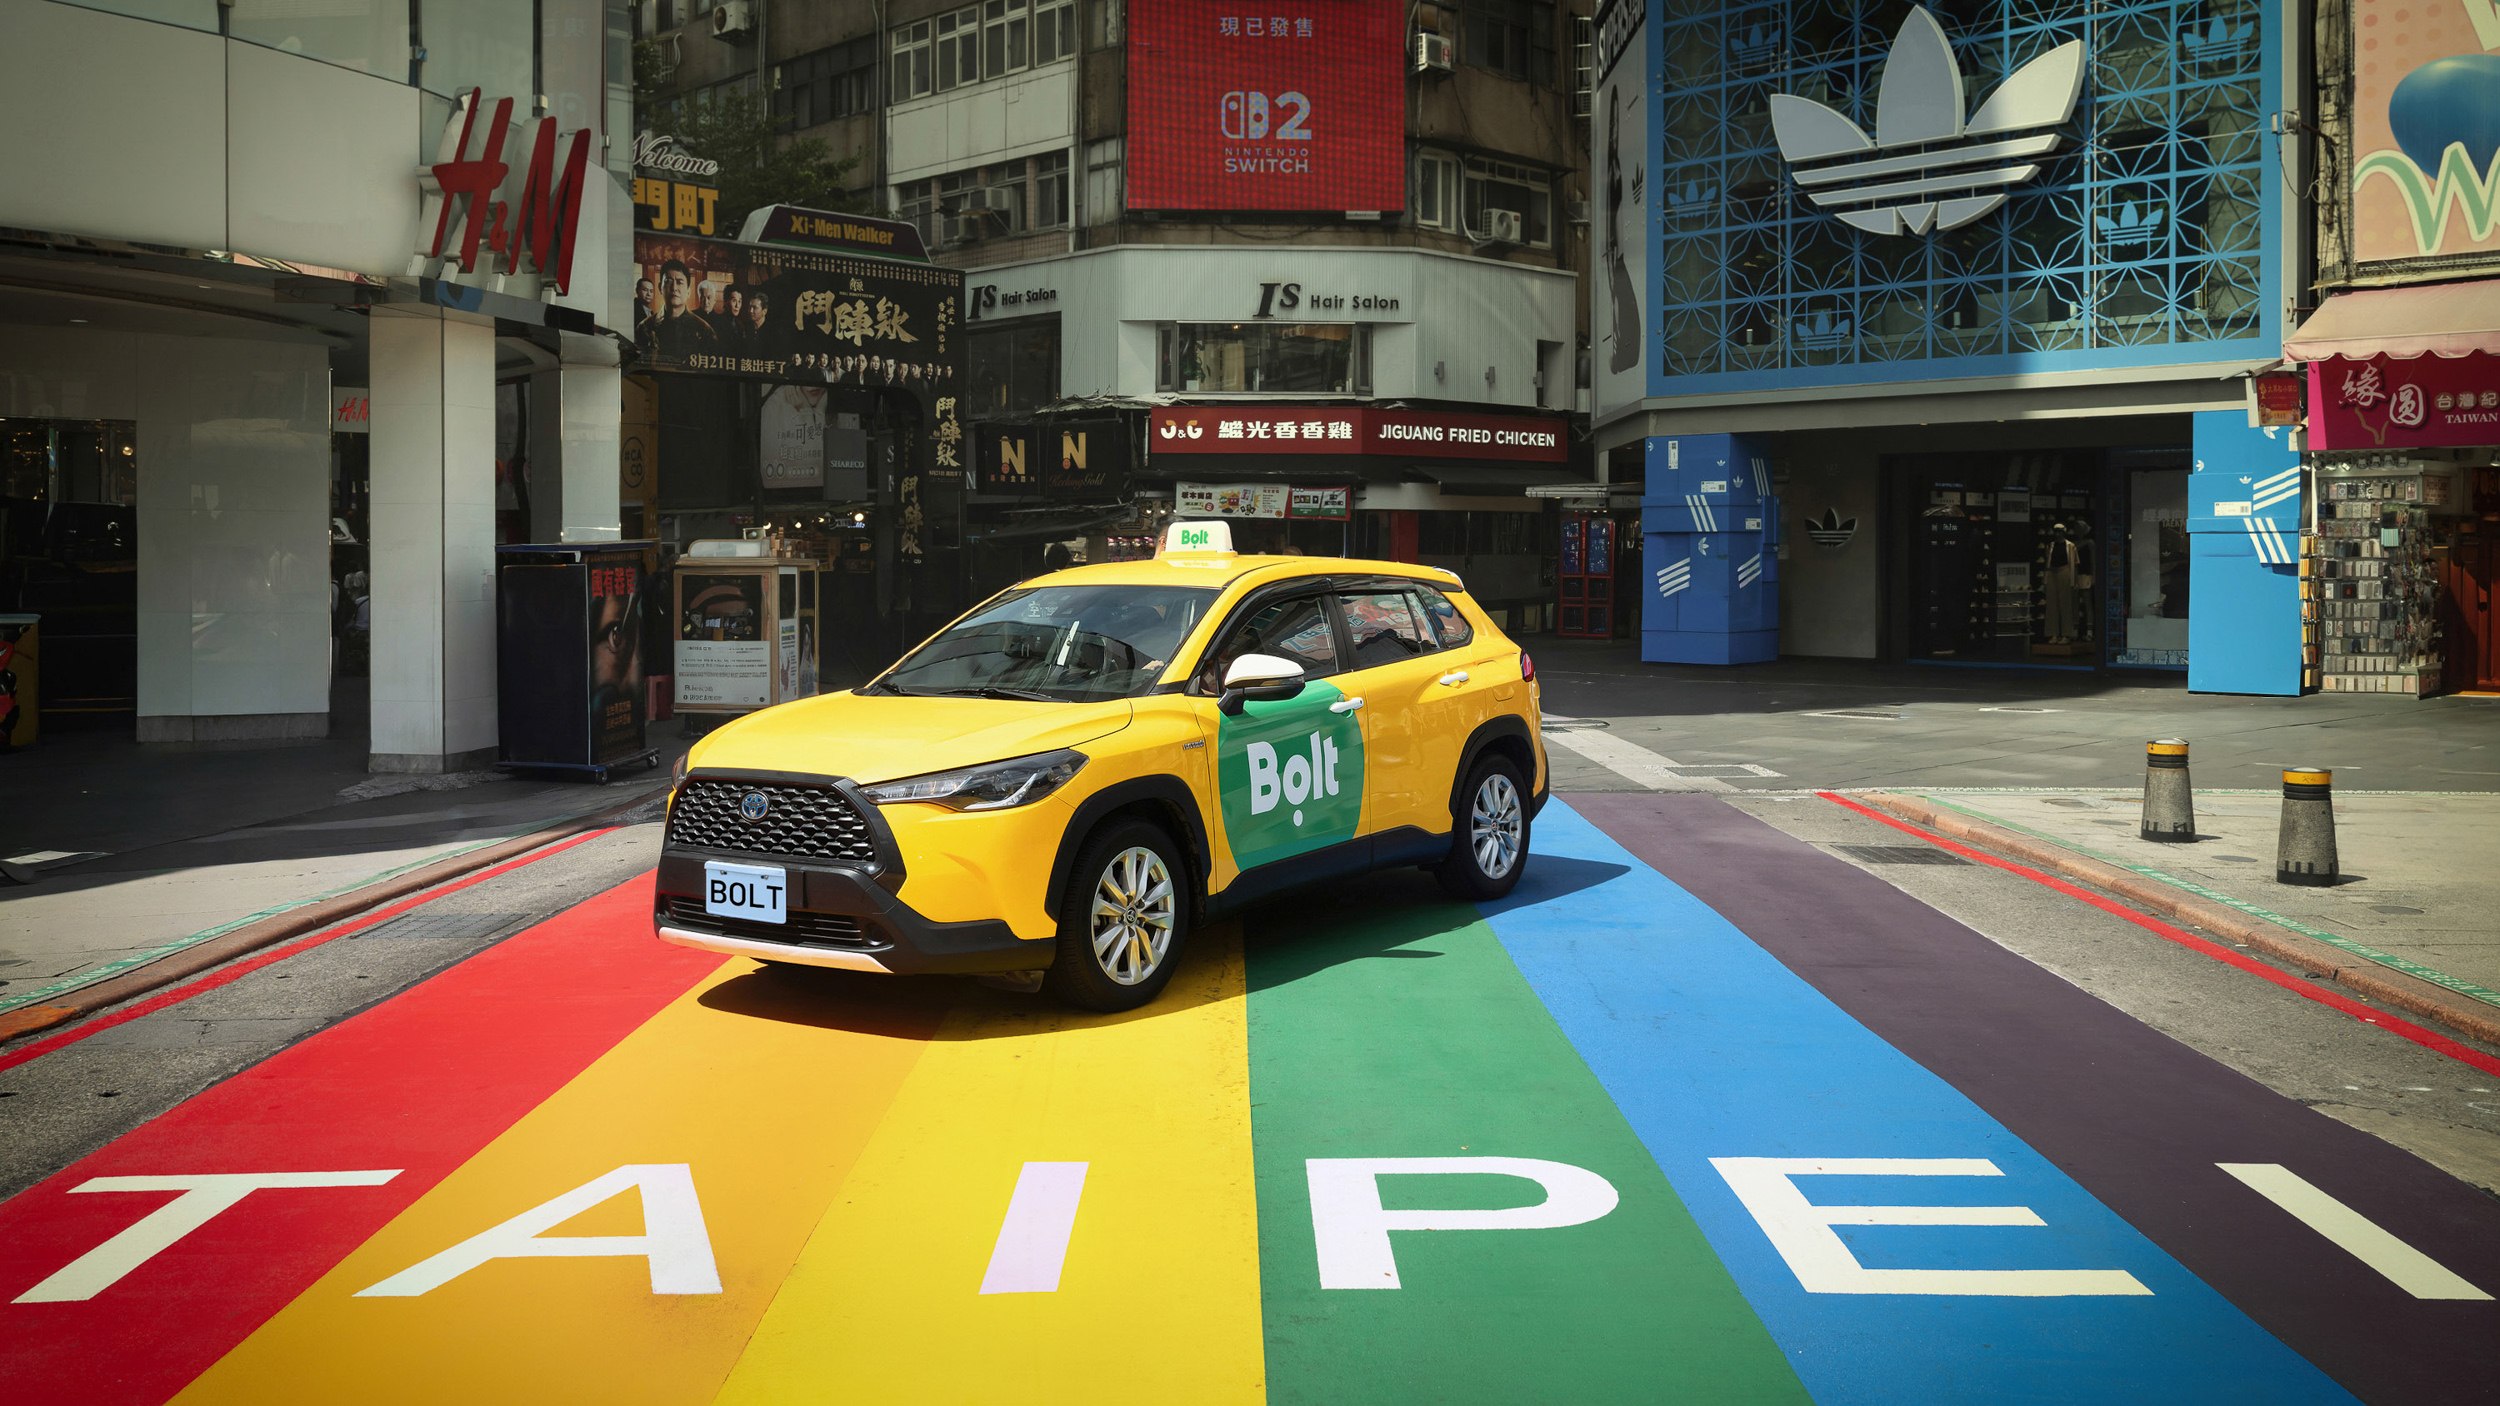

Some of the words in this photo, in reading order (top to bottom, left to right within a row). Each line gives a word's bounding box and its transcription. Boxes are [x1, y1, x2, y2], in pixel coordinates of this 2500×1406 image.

[1219, 17, 1313, 37] 現已發售
[1274, 91, 1312, 140] 2
[1225, 147, 1309, 156] NINTENDO
[1225, 158, 1309, 173] SWITCH
[430, 86, 591, 297] H&M
[790, 215, 842, 239] Xi-Men
[843, 223, 894, 246] Walker
[967, 285, 998, 320] IS
[1001, 291, 1024, 306] Hair
[1025, 287, 1057, 303] Salon
[1252, 282, 1302, 318] IS
[1310, 294, 1345, 310] Hair
[1352, 294, 1400, 310] Salon
[689, 353, 737, 371] 8月21日
[740, 357, 788, 375] 該出手了
[2444, 412, 2499, 424] TAIWAN
[1217, 420, 1353, 440] 繼光香香雞
[1379, 424, 1444, 442] JIGUANG
[1449, 427, 1492, 444] FRIED
[1496, 430, 1556, 447] CHICKEN
[630, 463, 644, 477] CO
[830, 460, 865, 470] SHARECO
[1181, 529, 1209, 549] Bolt
[1246, 730, 1340, 827] Bolt
[710, 878, 783, 911] BOLT
[2416, 970, 2484, 991] GREEN
[10, 1156, 2497, 1305] TAIPEI
